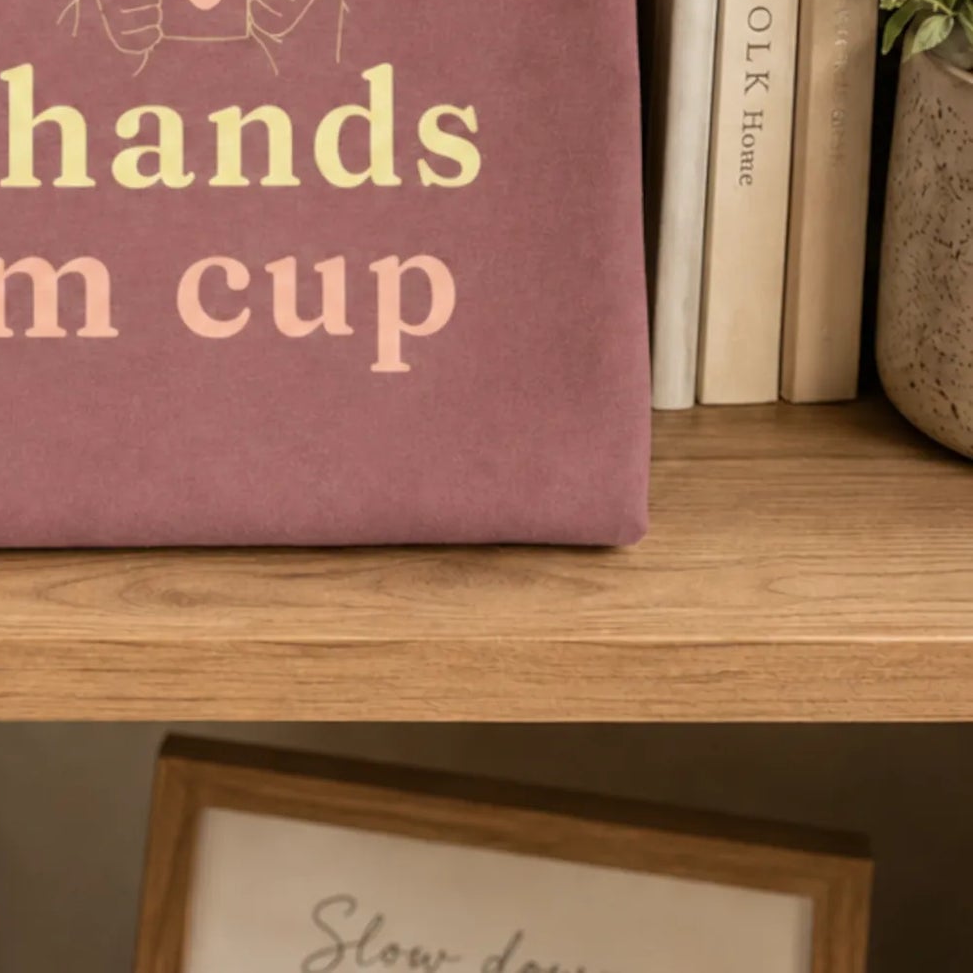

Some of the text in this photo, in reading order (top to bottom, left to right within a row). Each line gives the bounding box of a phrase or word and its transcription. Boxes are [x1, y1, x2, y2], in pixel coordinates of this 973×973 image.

[0, 63, 481, 189] hands
[738, 110, 764, 186] Home
[178, 255, 455, 372] cup
[300, 893, 617, 973] Slow do
